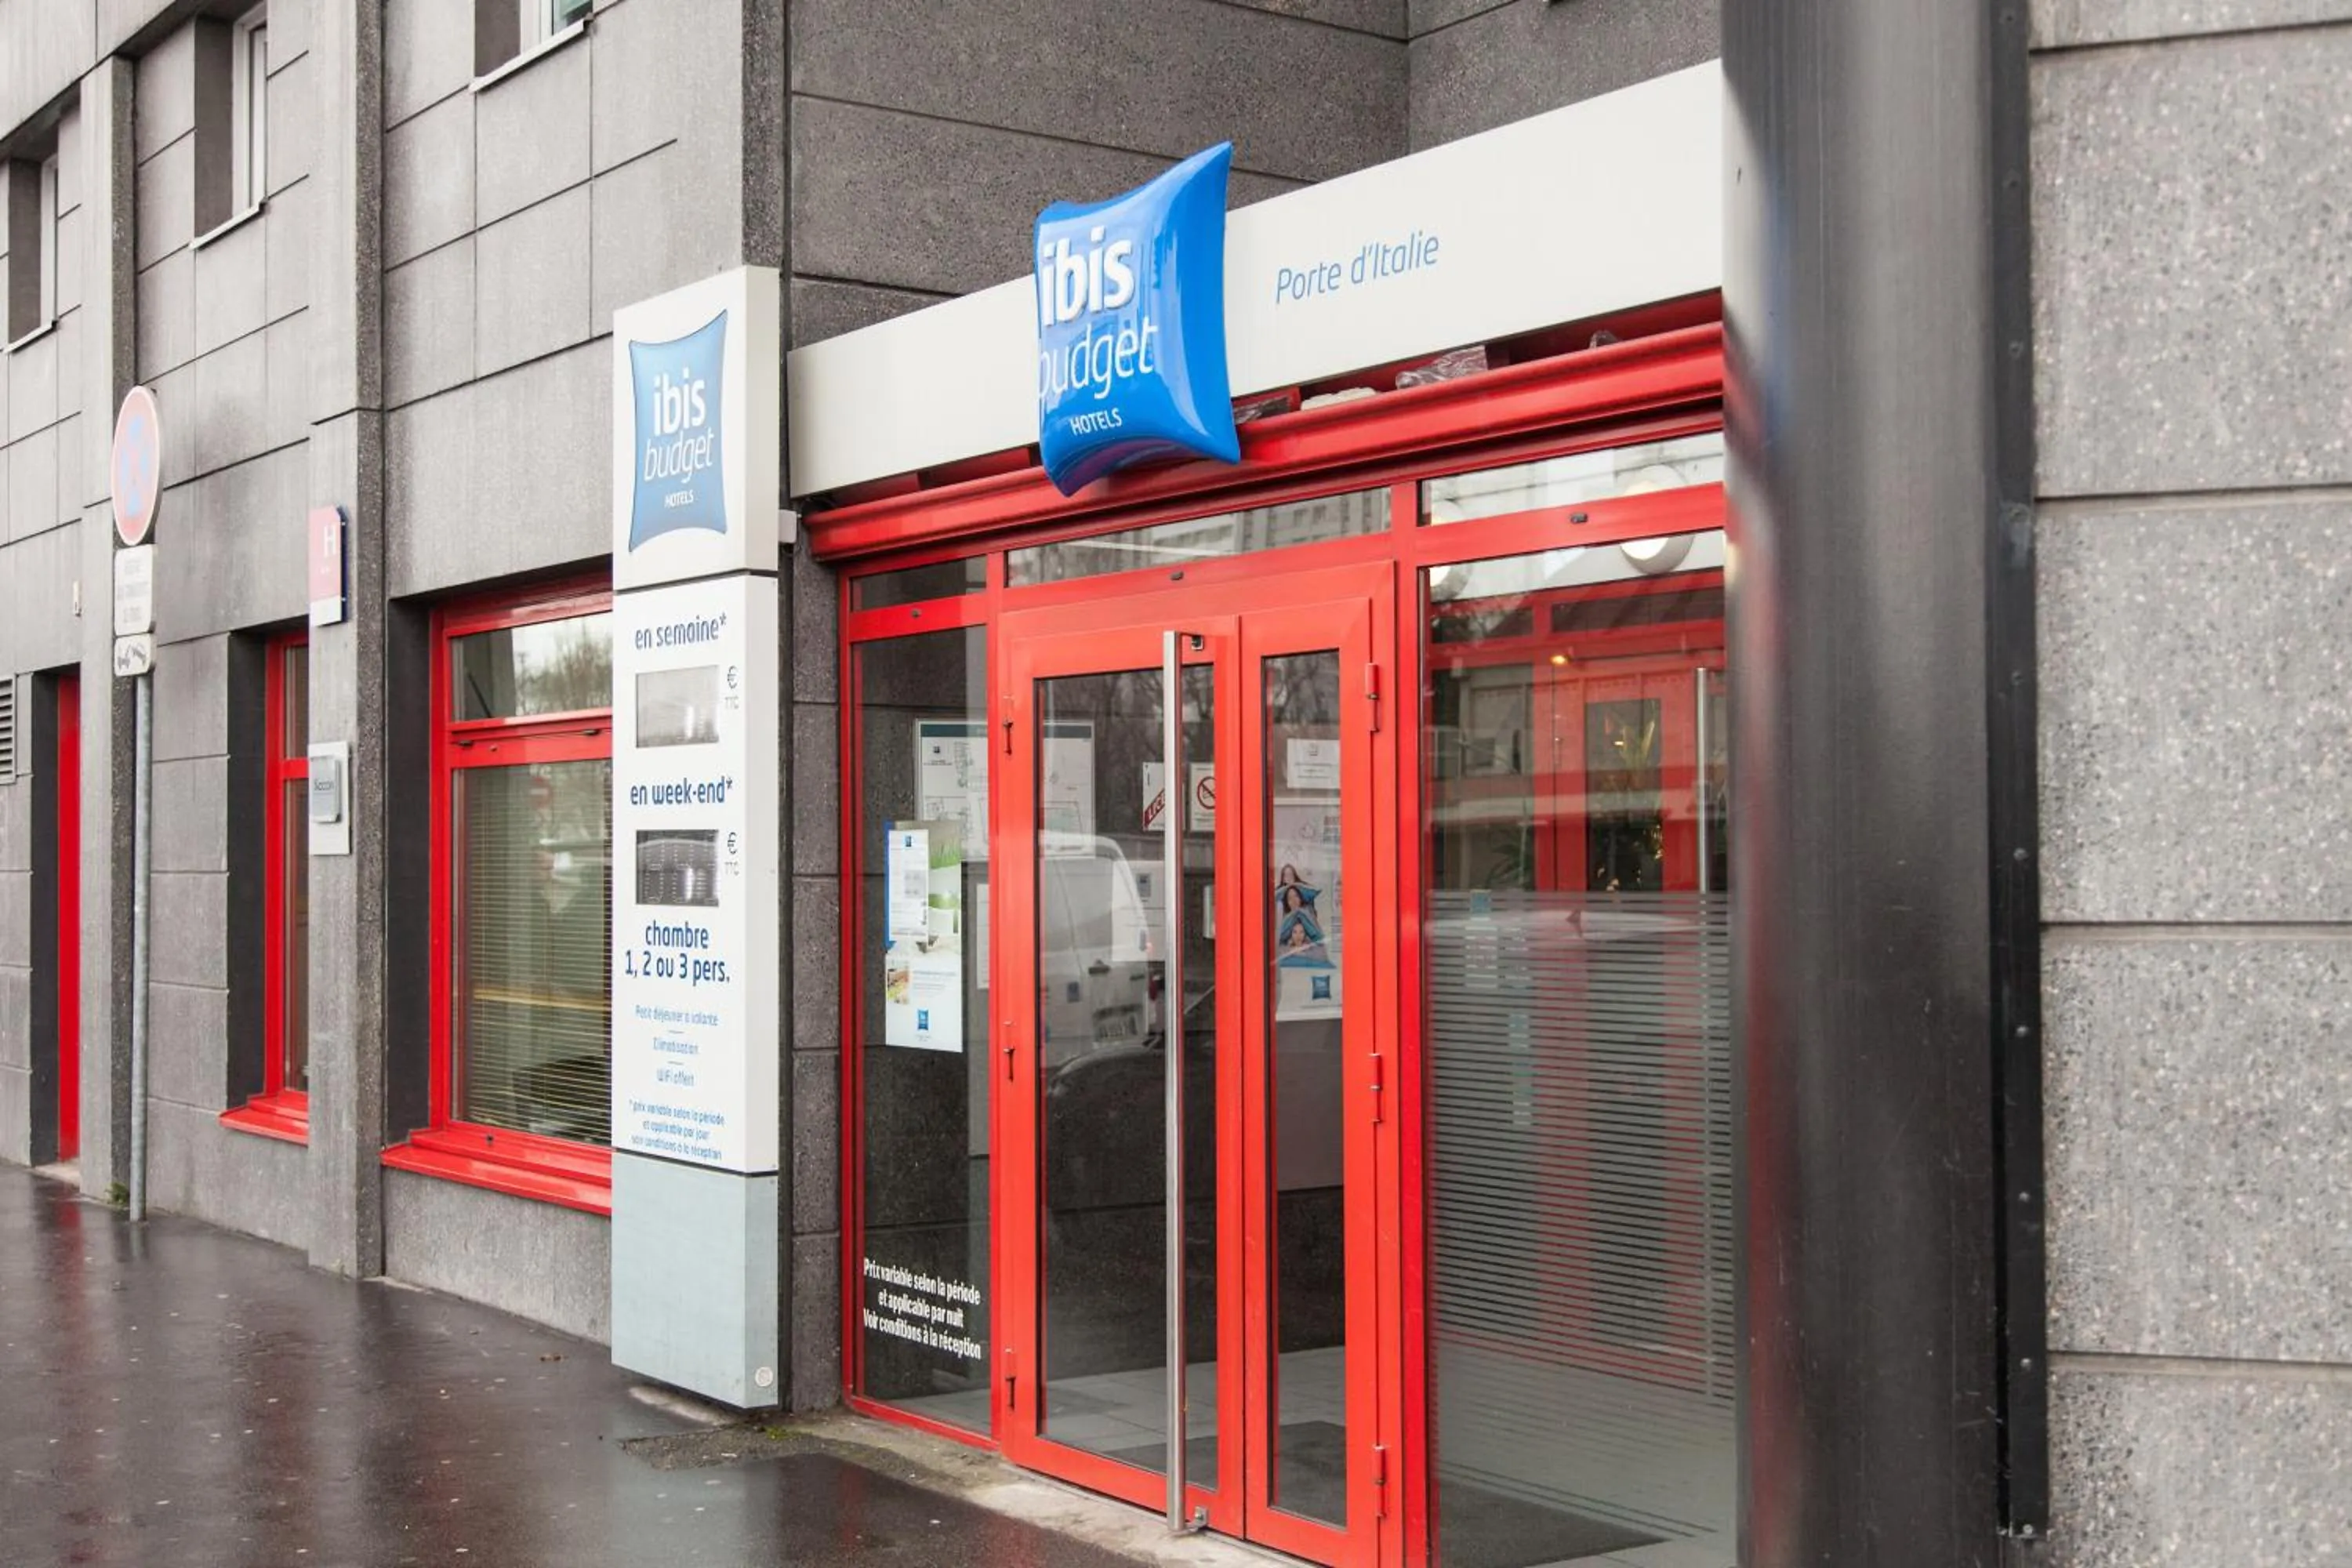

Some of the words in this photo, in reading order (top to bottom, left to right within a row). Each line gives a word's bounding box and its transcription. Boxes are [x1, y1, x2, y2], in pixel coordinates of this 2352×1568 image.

[1041, 224, 1135, 327] ibis
[1276, 262, 1341, 304] Porte
[654, 367, 706, 437] ibis
[1070, 408, 1123, 436] HOTELS
[644, 426, 714, 483] budget
[665, 489, 695, 510] HOTELS
[324, 524, 336, 558] H
[635, 628, 652, 650] en
[727, 665, 738, 689] €
[630, 784, 648, 805] en
[727, 832, 738, 855] €
[645, 919, 710, 949] chambre
[642, 950, 652, 976] 2
[656, 956, 673, 978] ou
[679, 953, 688, 979] 3
[692, 959, 730, 986] pers.
[864, 1257, 880, 1280] Prix
[880, 1264, 913, 1290] variable
[913, 1273, 936, 1294] selon
[938, 1276, 946, 1297] la
[946, 1279, 981, 1305] période
[879, 1289, 887, 1307] et
[887, 1294, 930, 1319] applicable
[931, 1305, 946, 1325] par
[946, 1307, 964, 1328] nuit
[863, 1308, 879, 1330] Voir
[880, 1316, 922, 1343] conditions
[923, 1323, 929, 1344] à
[930, 1327, 938, 1346] la
[938, 1330, 982, 1360] réception
